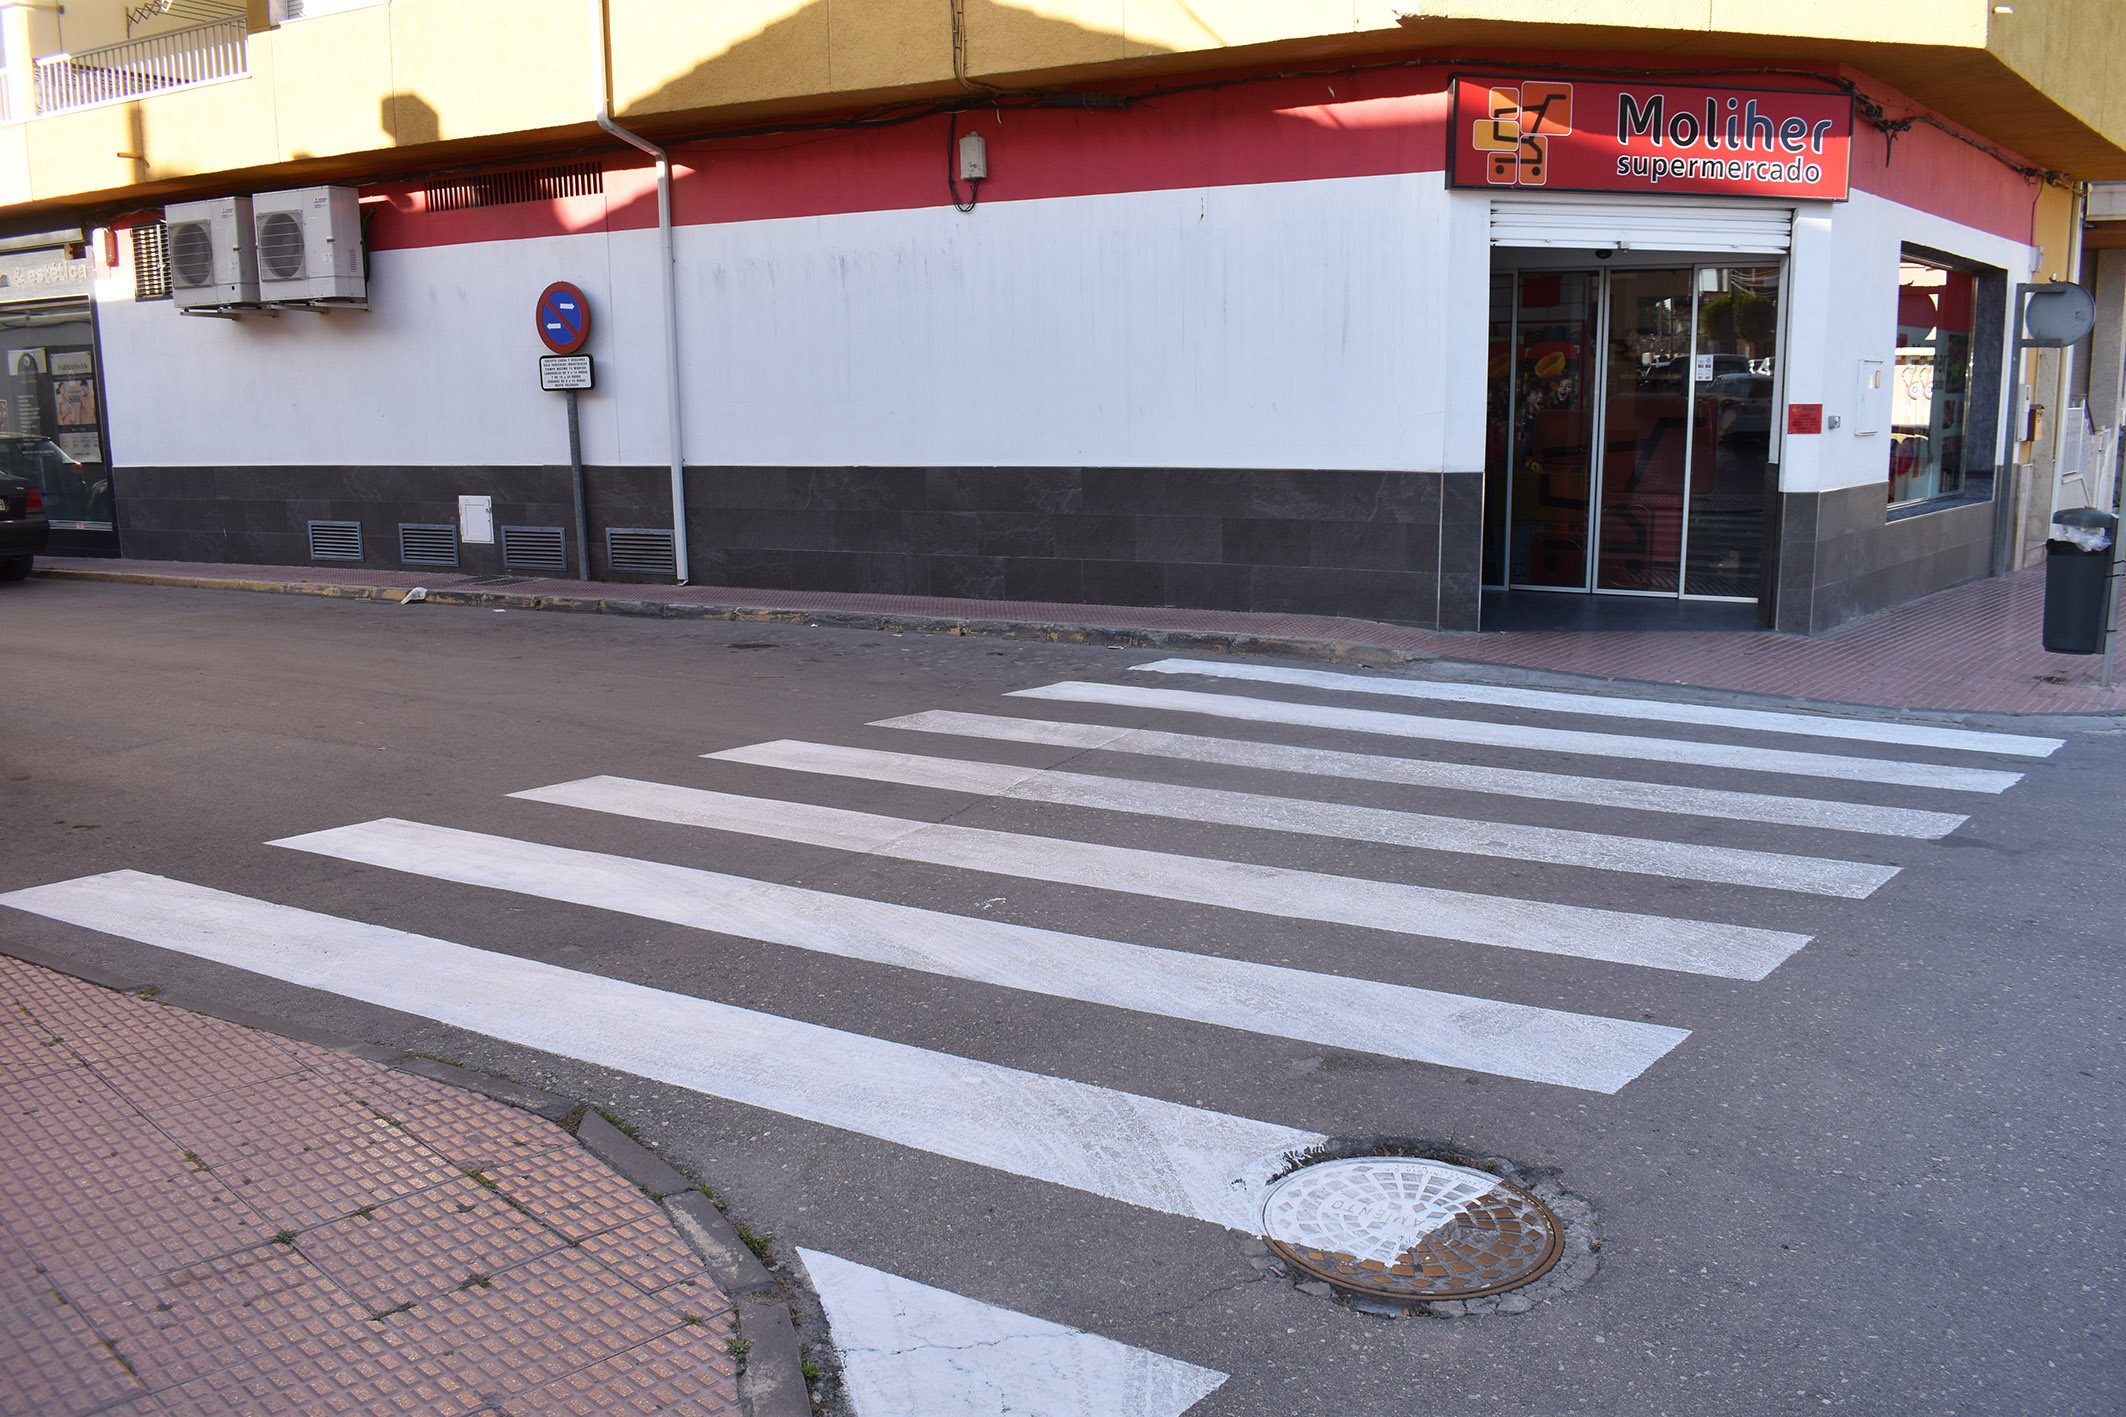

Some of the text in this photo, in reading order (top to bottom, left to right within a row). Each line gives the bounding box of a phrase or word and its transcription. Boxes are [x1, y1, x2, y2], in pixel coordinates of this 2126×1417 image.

[1617, 92, 1832, 154] Moliher
[1616, 153, 1823, 183] supermercado
[28, 261, 88, 284] estética
